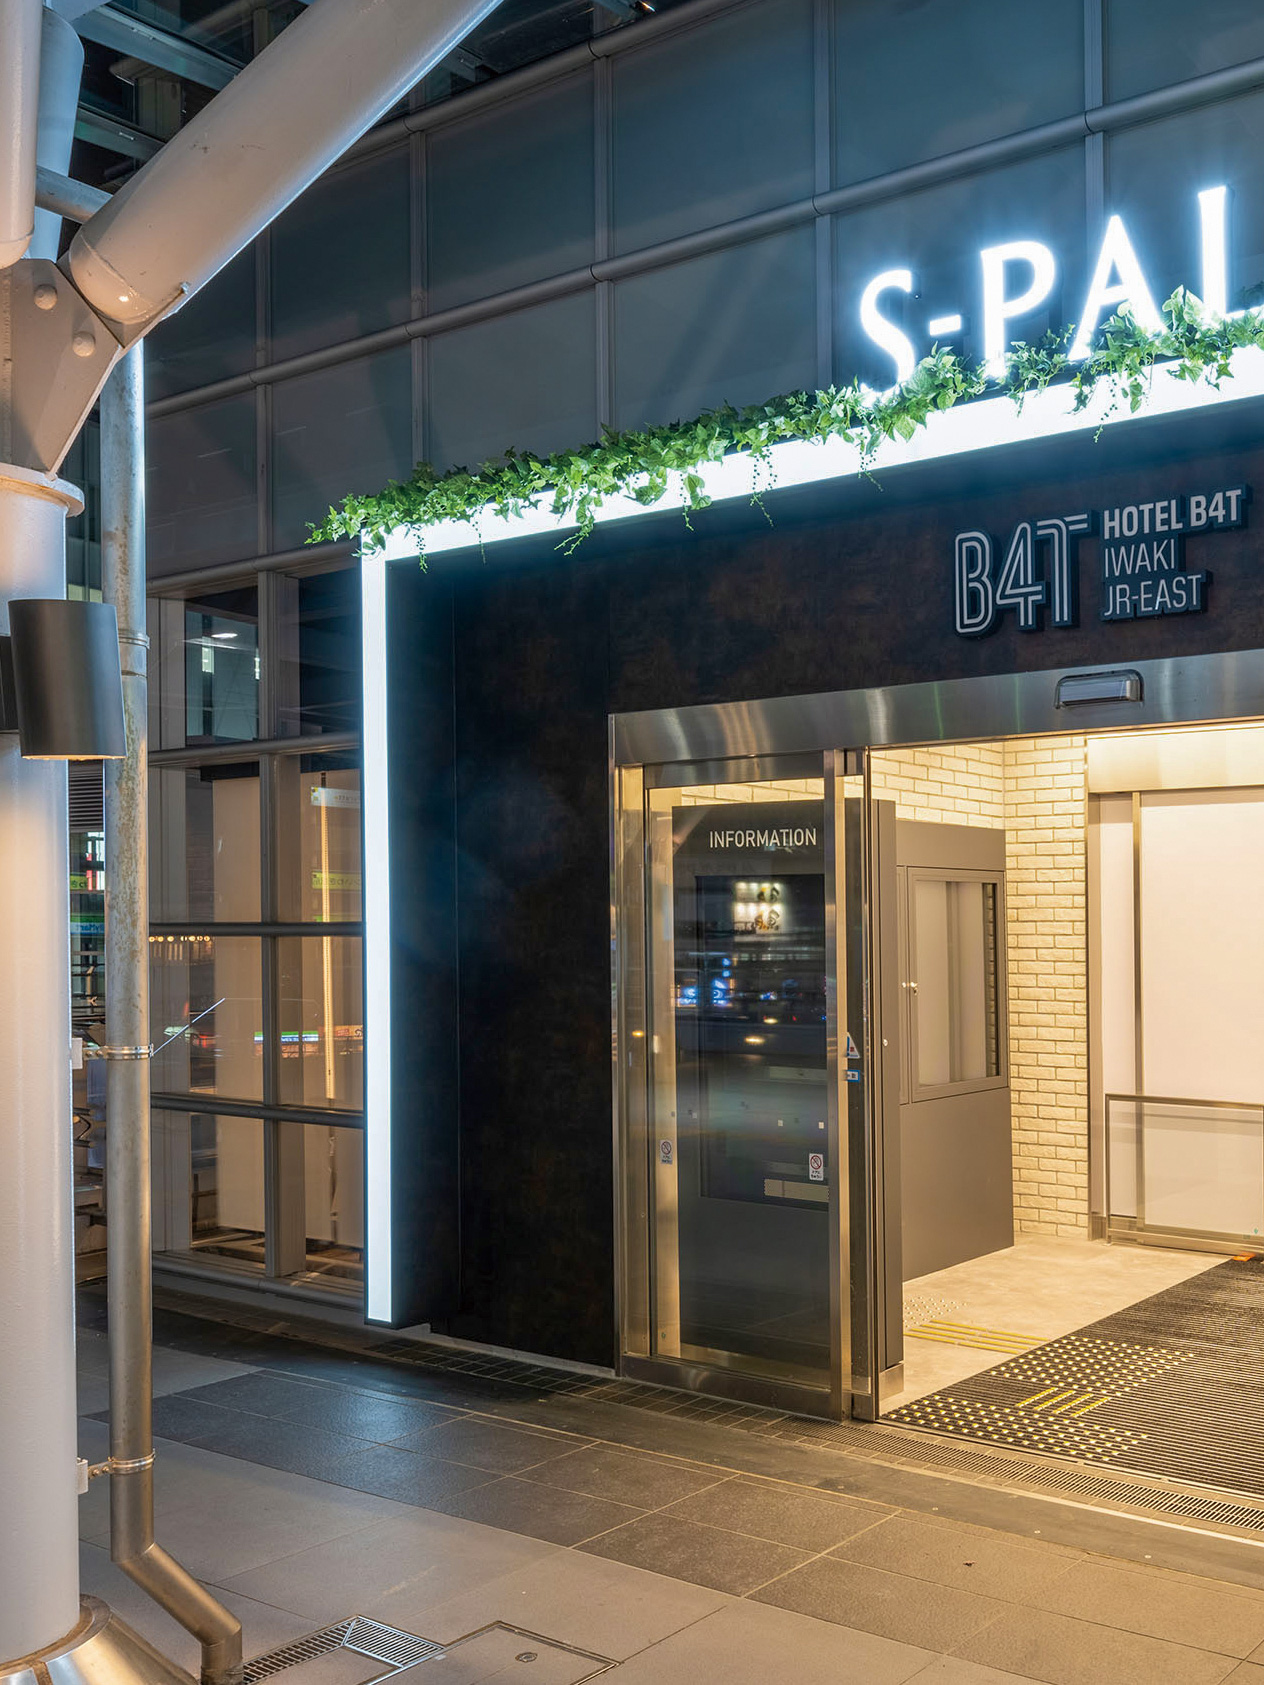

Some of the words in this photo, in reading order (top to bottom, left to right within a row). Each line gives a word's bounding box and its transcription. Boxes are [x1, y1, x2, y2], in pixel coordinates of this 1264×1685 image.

[1104, 500, 1183, 540] HOTEL
[1190, 490, 1243, 527] B4T
[954, 514, 1089, 634] B4T
[1104, 538, 1176, 576] IWAKI
[1104, 575, 1203, 617] JR-EAST
[709, 828, 817, 848] INFORMATION
